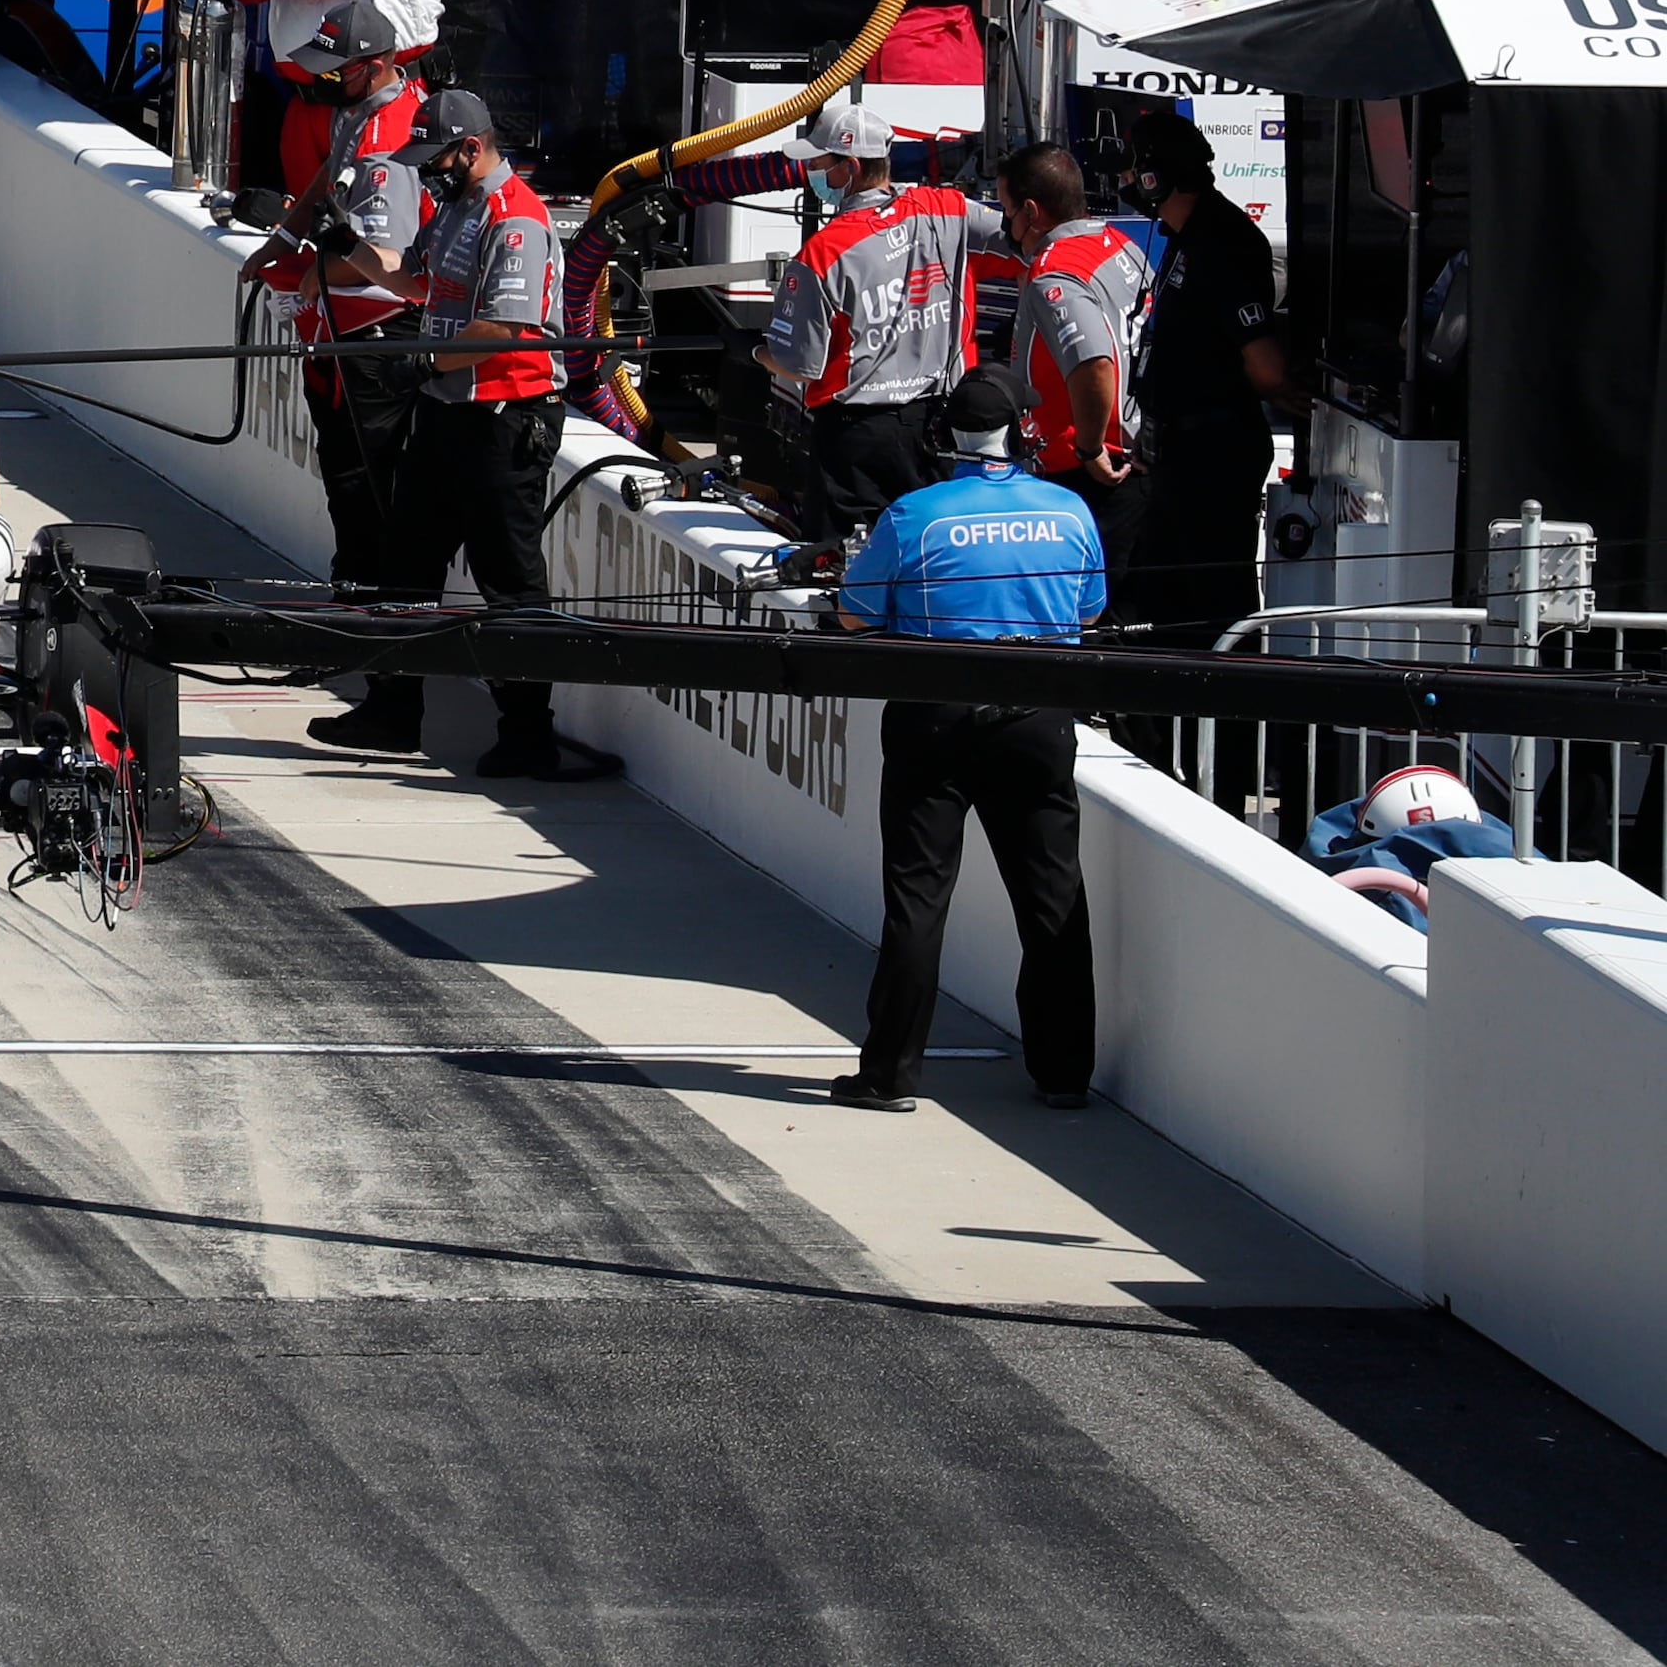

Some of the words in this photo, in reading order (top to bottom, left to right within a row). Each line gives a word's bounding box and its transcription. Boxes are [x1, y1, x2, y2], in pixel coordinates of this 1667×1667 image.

[1092, 71, 1279, 96] HONDA
[1198, 124, 1254, 136] AINBRIDGE
[1222, 162, 1285, 179] UniFirst
[861, 281, 907, 325] US
[950, 521, 1064, 548] OFFICIAL
